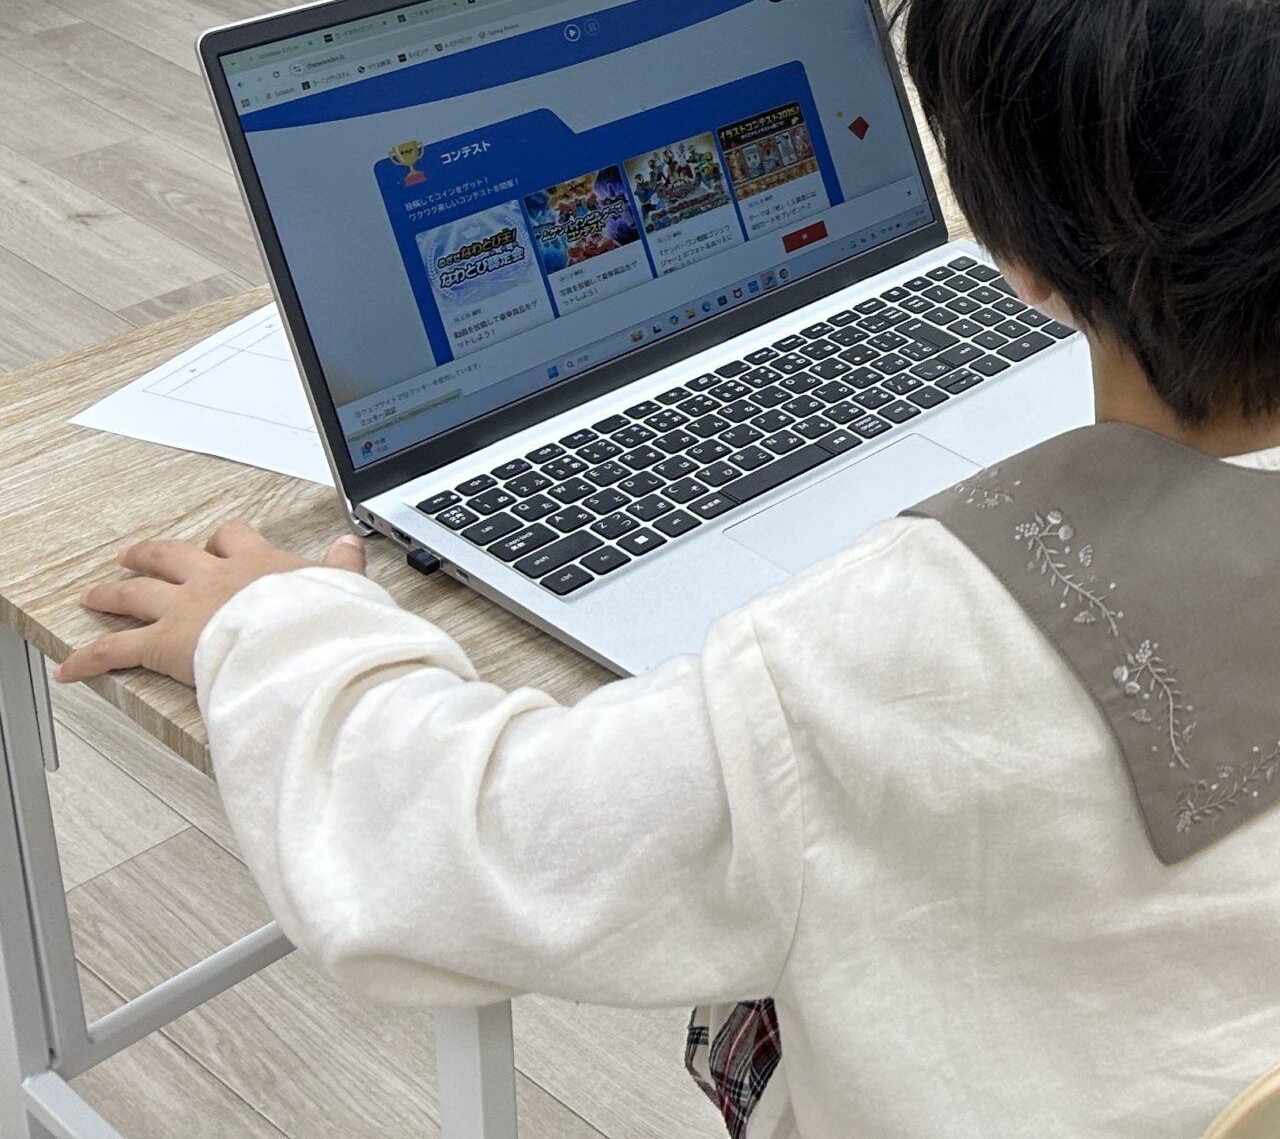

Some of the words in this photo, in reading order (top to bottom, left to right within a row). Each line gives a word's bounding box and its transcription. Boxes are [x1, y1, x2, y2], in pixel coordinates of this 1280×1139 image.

[440, 139, 491, 164] コンテスト
